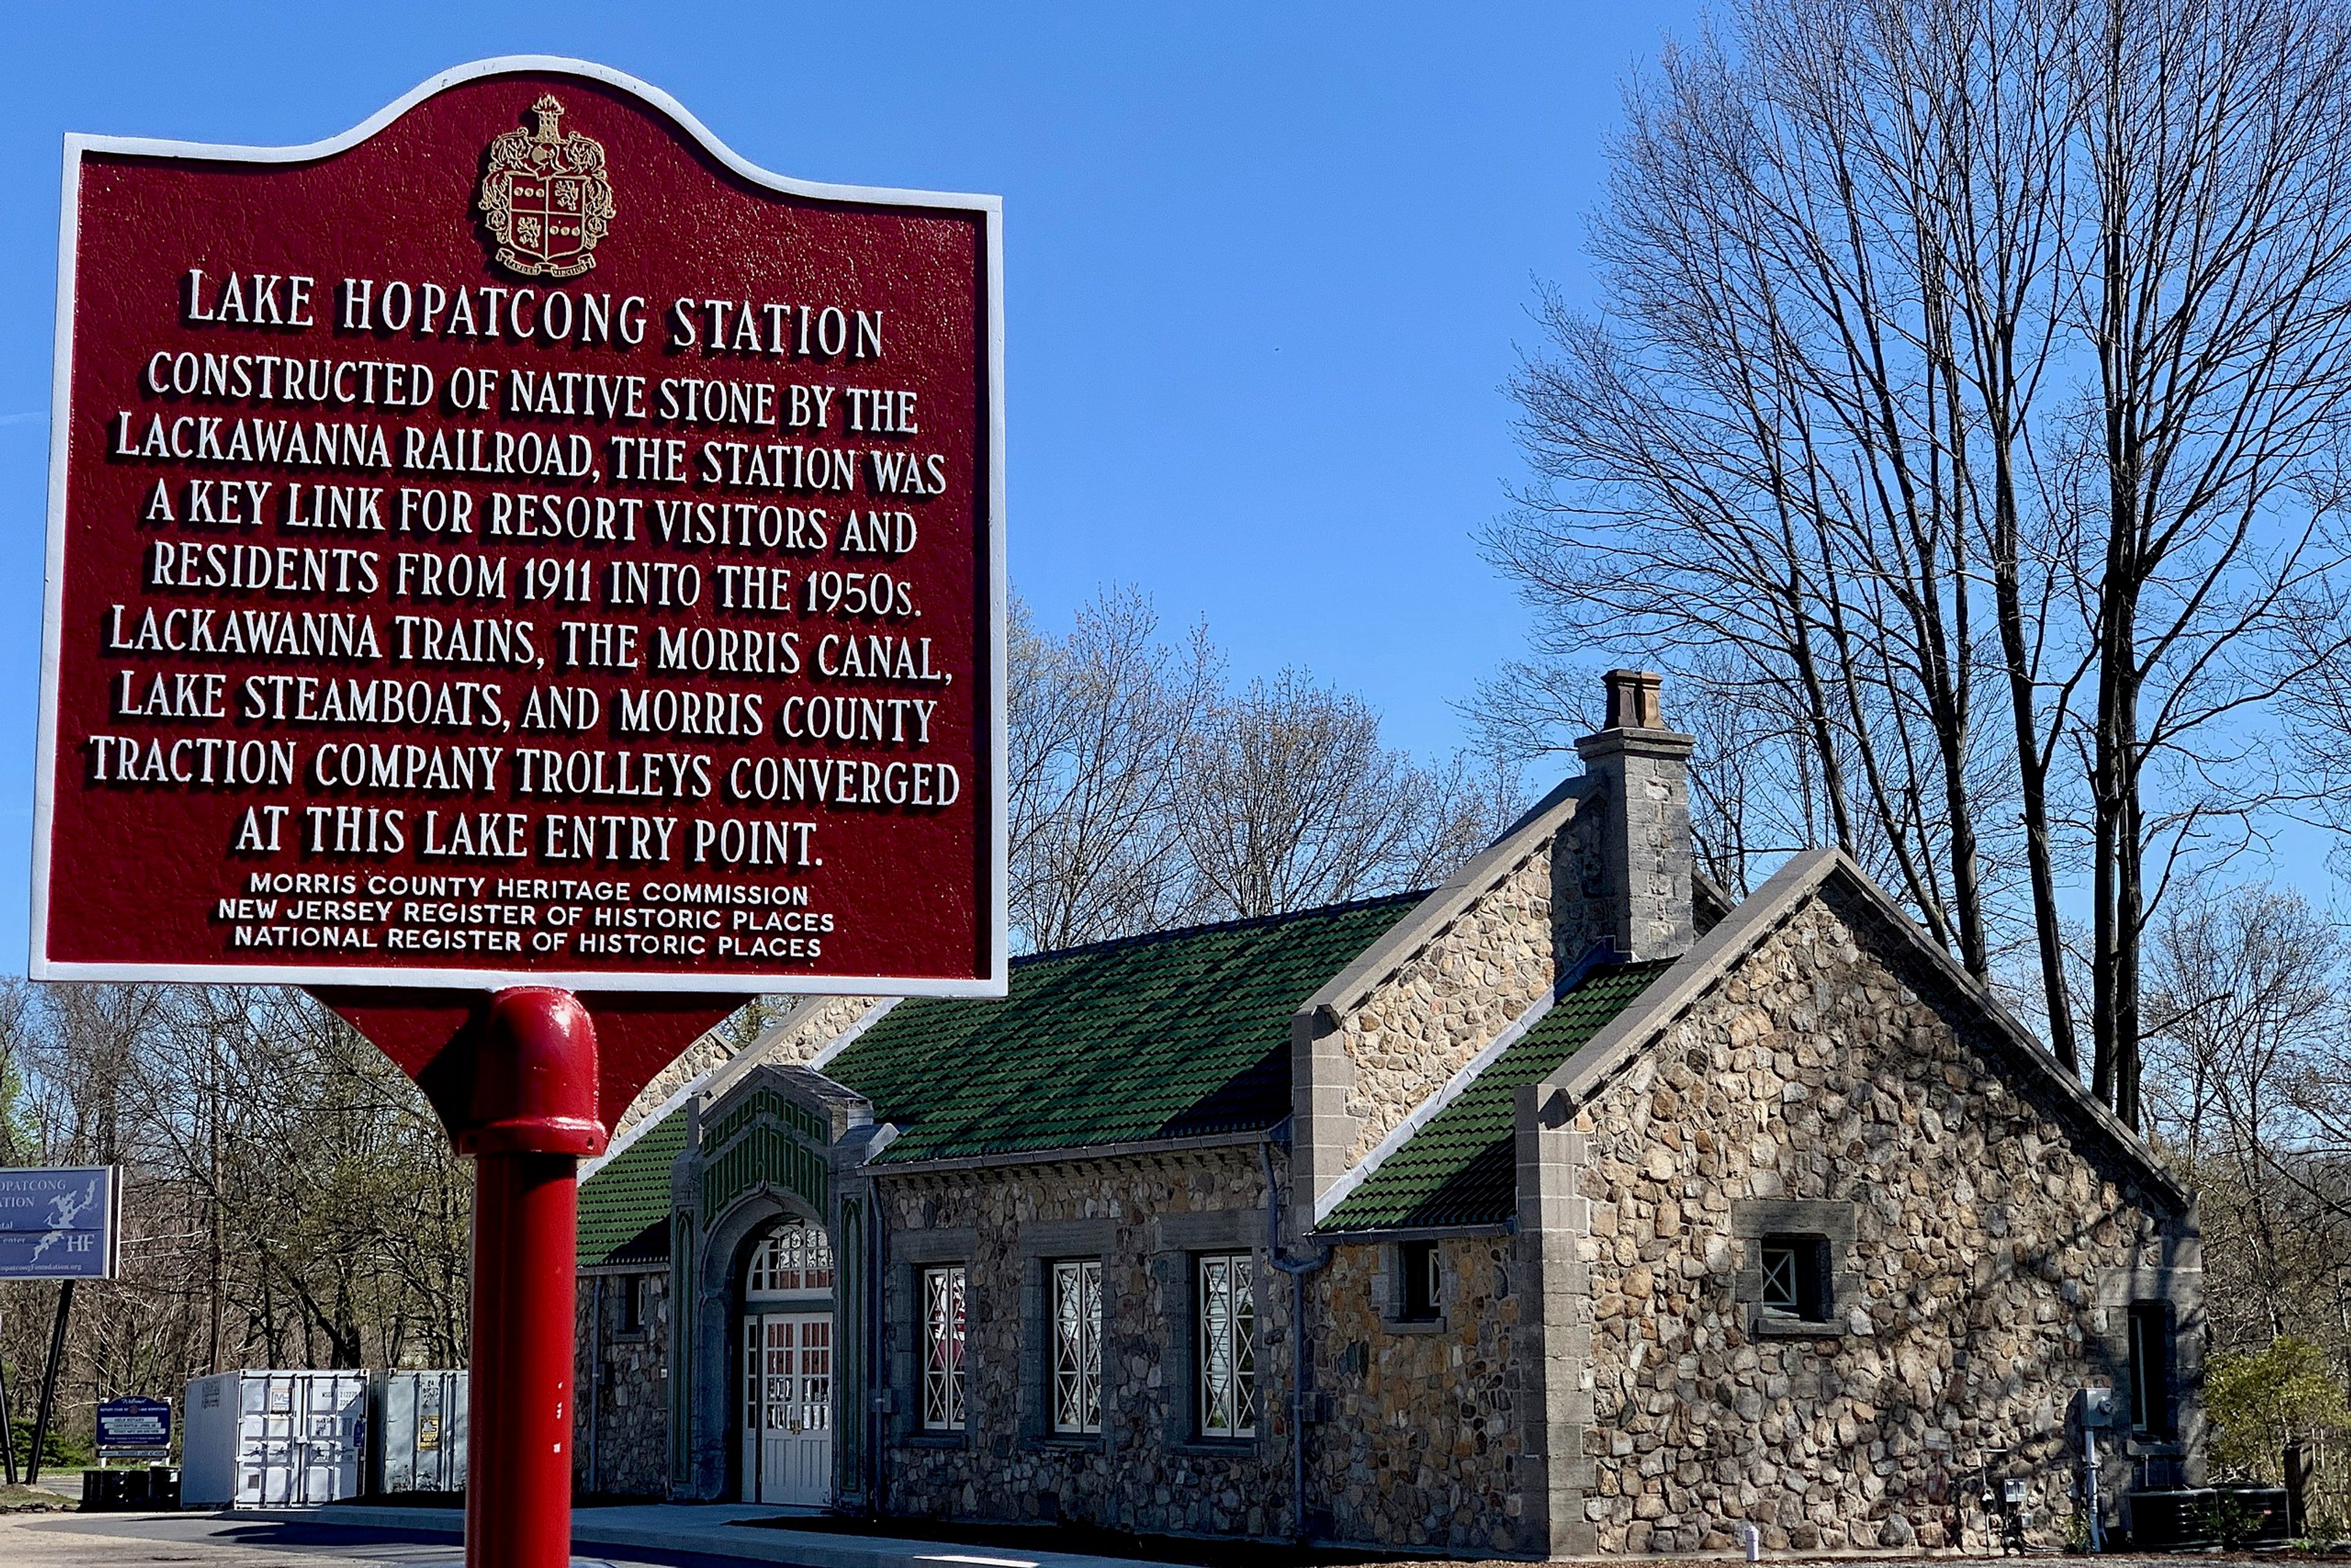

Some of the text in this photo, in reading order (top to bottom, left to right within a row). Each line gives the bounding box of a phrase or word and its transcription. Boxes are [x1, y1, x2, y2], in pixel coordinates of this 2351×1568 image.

[187, 268, 883, 358] LAKE HOPATCONG STATION
[148, 351, 918, 434] CONSTRUCTED OF NATIVE STONE BY THE
[116, 410, 946, 494] LACKAWANNA RAILROAD, THE STATION WAS
[146, 478, 918, 553] A KEY LINK FOR RESORT VISITORS AND
[151, 539, 379, 593] RESIDENTS
[396, 552, 507, 599] FROM
[524, 558, 591, 602] 1911
[610, 561, 700, 606] INTO
[717, 565, 791, 611] THE
[110, 604, 952, 686] LACKAWANNA TRAINS, THE MORRIS CANAL,
[119, 670, 937, 743] LAKE STEAMBOATS, AND MORRIS COUNTY
[89, 735, 959, 806] TRACTION COMPANY TROLLEYS CONVERGED
[235, 805, 823, 866] AT THIS LAKE ENTRY POINT.
[219, 898, 834, 932] NEW JERSEY REGISTER OF HISTORIC PLACES
[250, 872, 808, 906] MORRIS COUNTY HERITAGE COMMISSION
[235, 926, 821, 957] NATIONAL REGISTER OF HISTORIC PLACES
[0, 1221, 13, 1230] tal
[67, 1234, 95, 1253] HF
